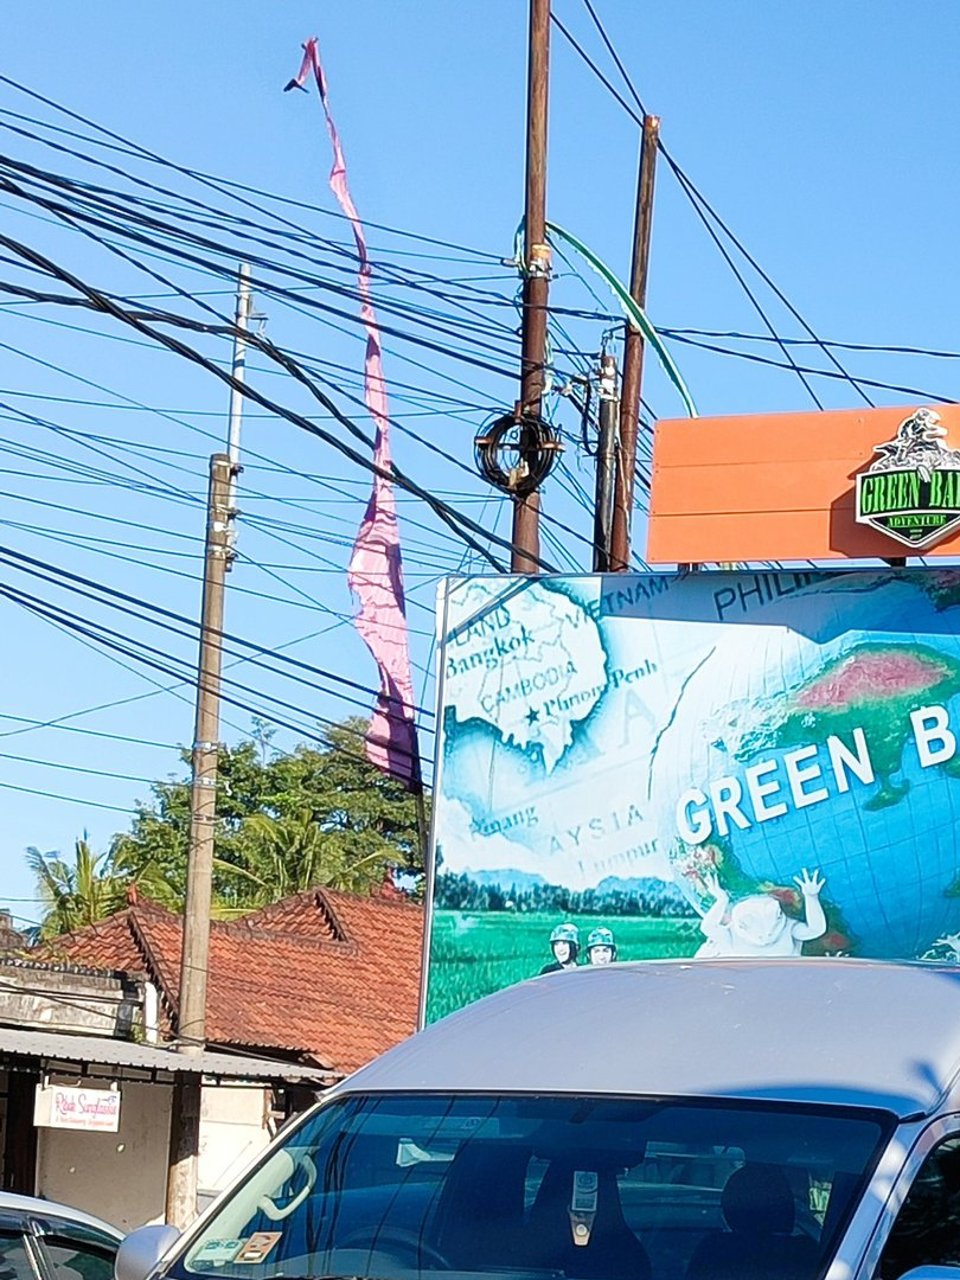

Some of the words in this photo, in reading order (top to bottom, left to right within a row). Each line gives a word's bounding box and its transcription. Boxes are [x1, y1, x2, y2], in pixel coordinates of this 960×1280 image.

[861, 472, 919, 514] GREEN
[887, 514, 947, 528] ADVENTURE
[446, 624, 535, 680] Bangkok
[610, 658, 659, 689] Penh
[480, 659, 579, 714] CAMBODIA
[676, 727, 875, 845] GREEN
